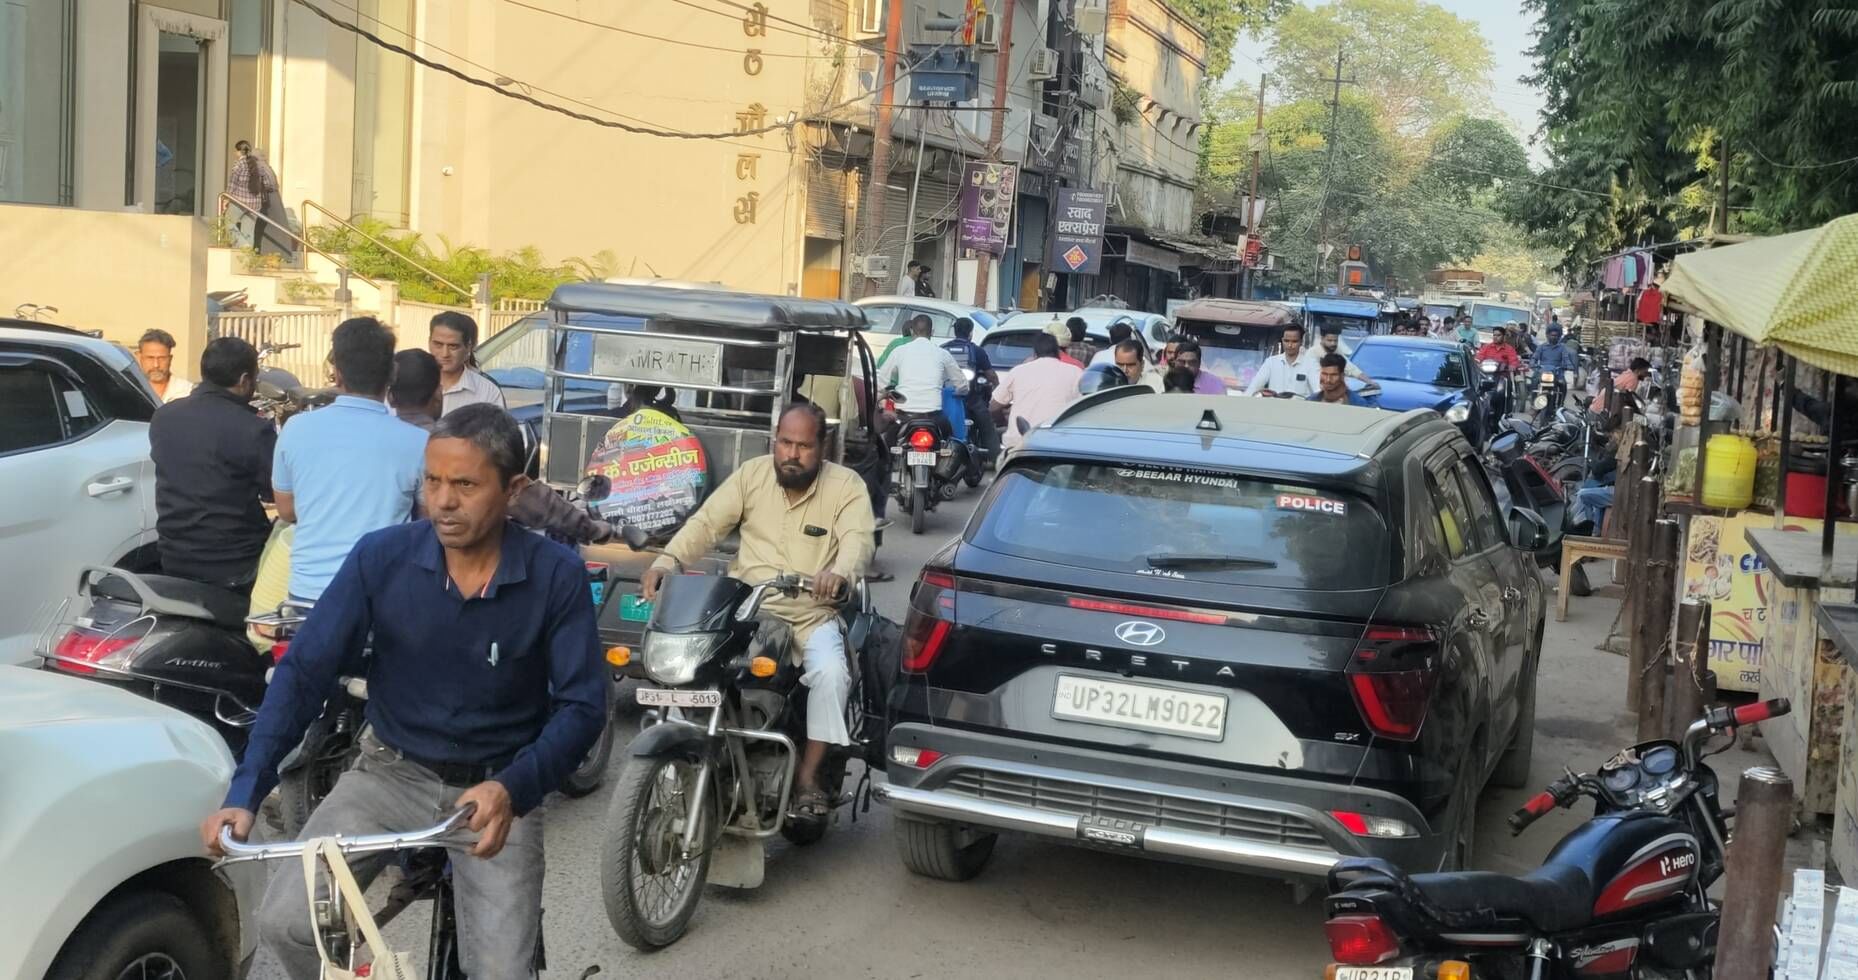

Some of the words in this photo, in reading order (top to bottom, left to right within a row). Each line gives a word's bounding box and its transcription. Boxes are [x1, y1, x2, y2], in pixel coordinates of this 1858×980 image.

[1067, 206, 1094, 220] स्वाद
[1135, 470, 1182, 482] BEEAAR
[1184, 474, 1238, 489] HYUNDAI
[1280, 496, 1344, 515] POLICE
[1041, 643, 1235, 678] CRETA
[1709, 639, 1737, 663] गर
[1072, 685, 1221, 730] UP32LM9022
[1673, 853, 1694, 869] Hero
